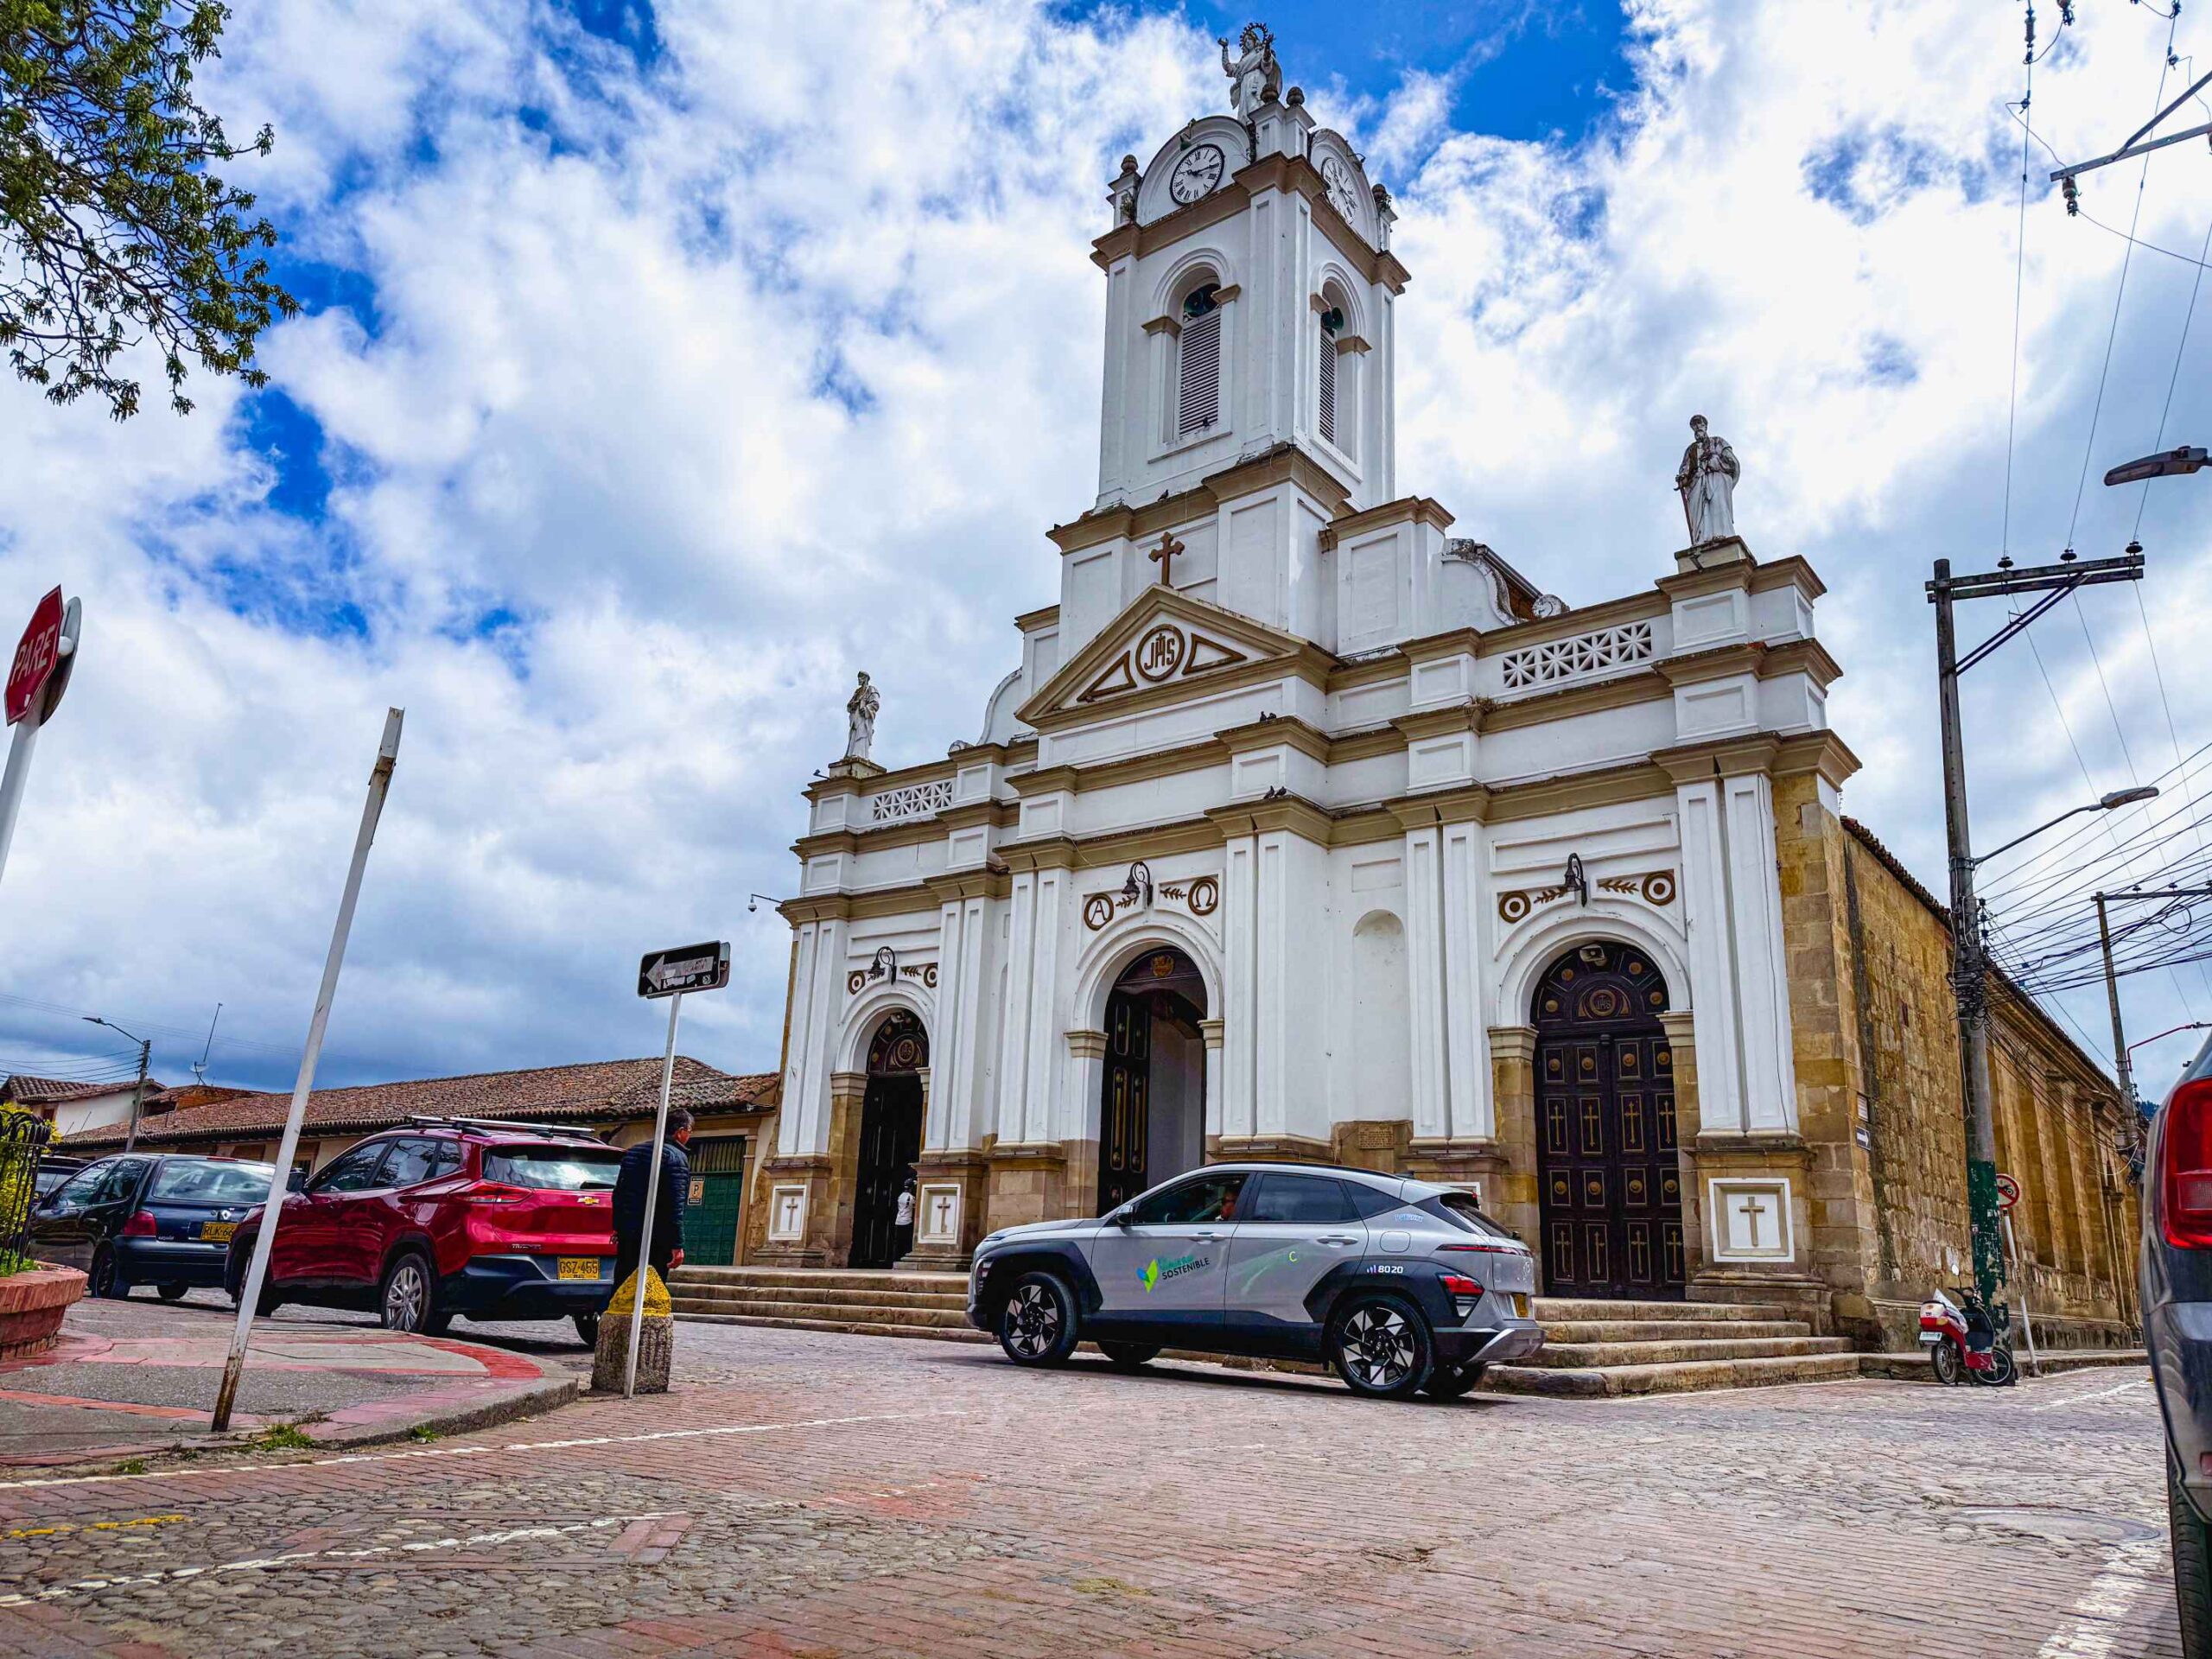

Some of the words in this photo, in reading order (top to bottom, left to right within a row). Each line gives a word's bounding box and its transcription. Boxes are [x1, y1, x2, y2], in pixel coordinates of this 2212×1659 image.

[10, 623, 56, 686] PARE
[1196, 883, 1212, 907] Ω
[1161, 1257, 1211, 1280] SOSTENIBLE
[1377, 1265, 1404, 1274] 8020
